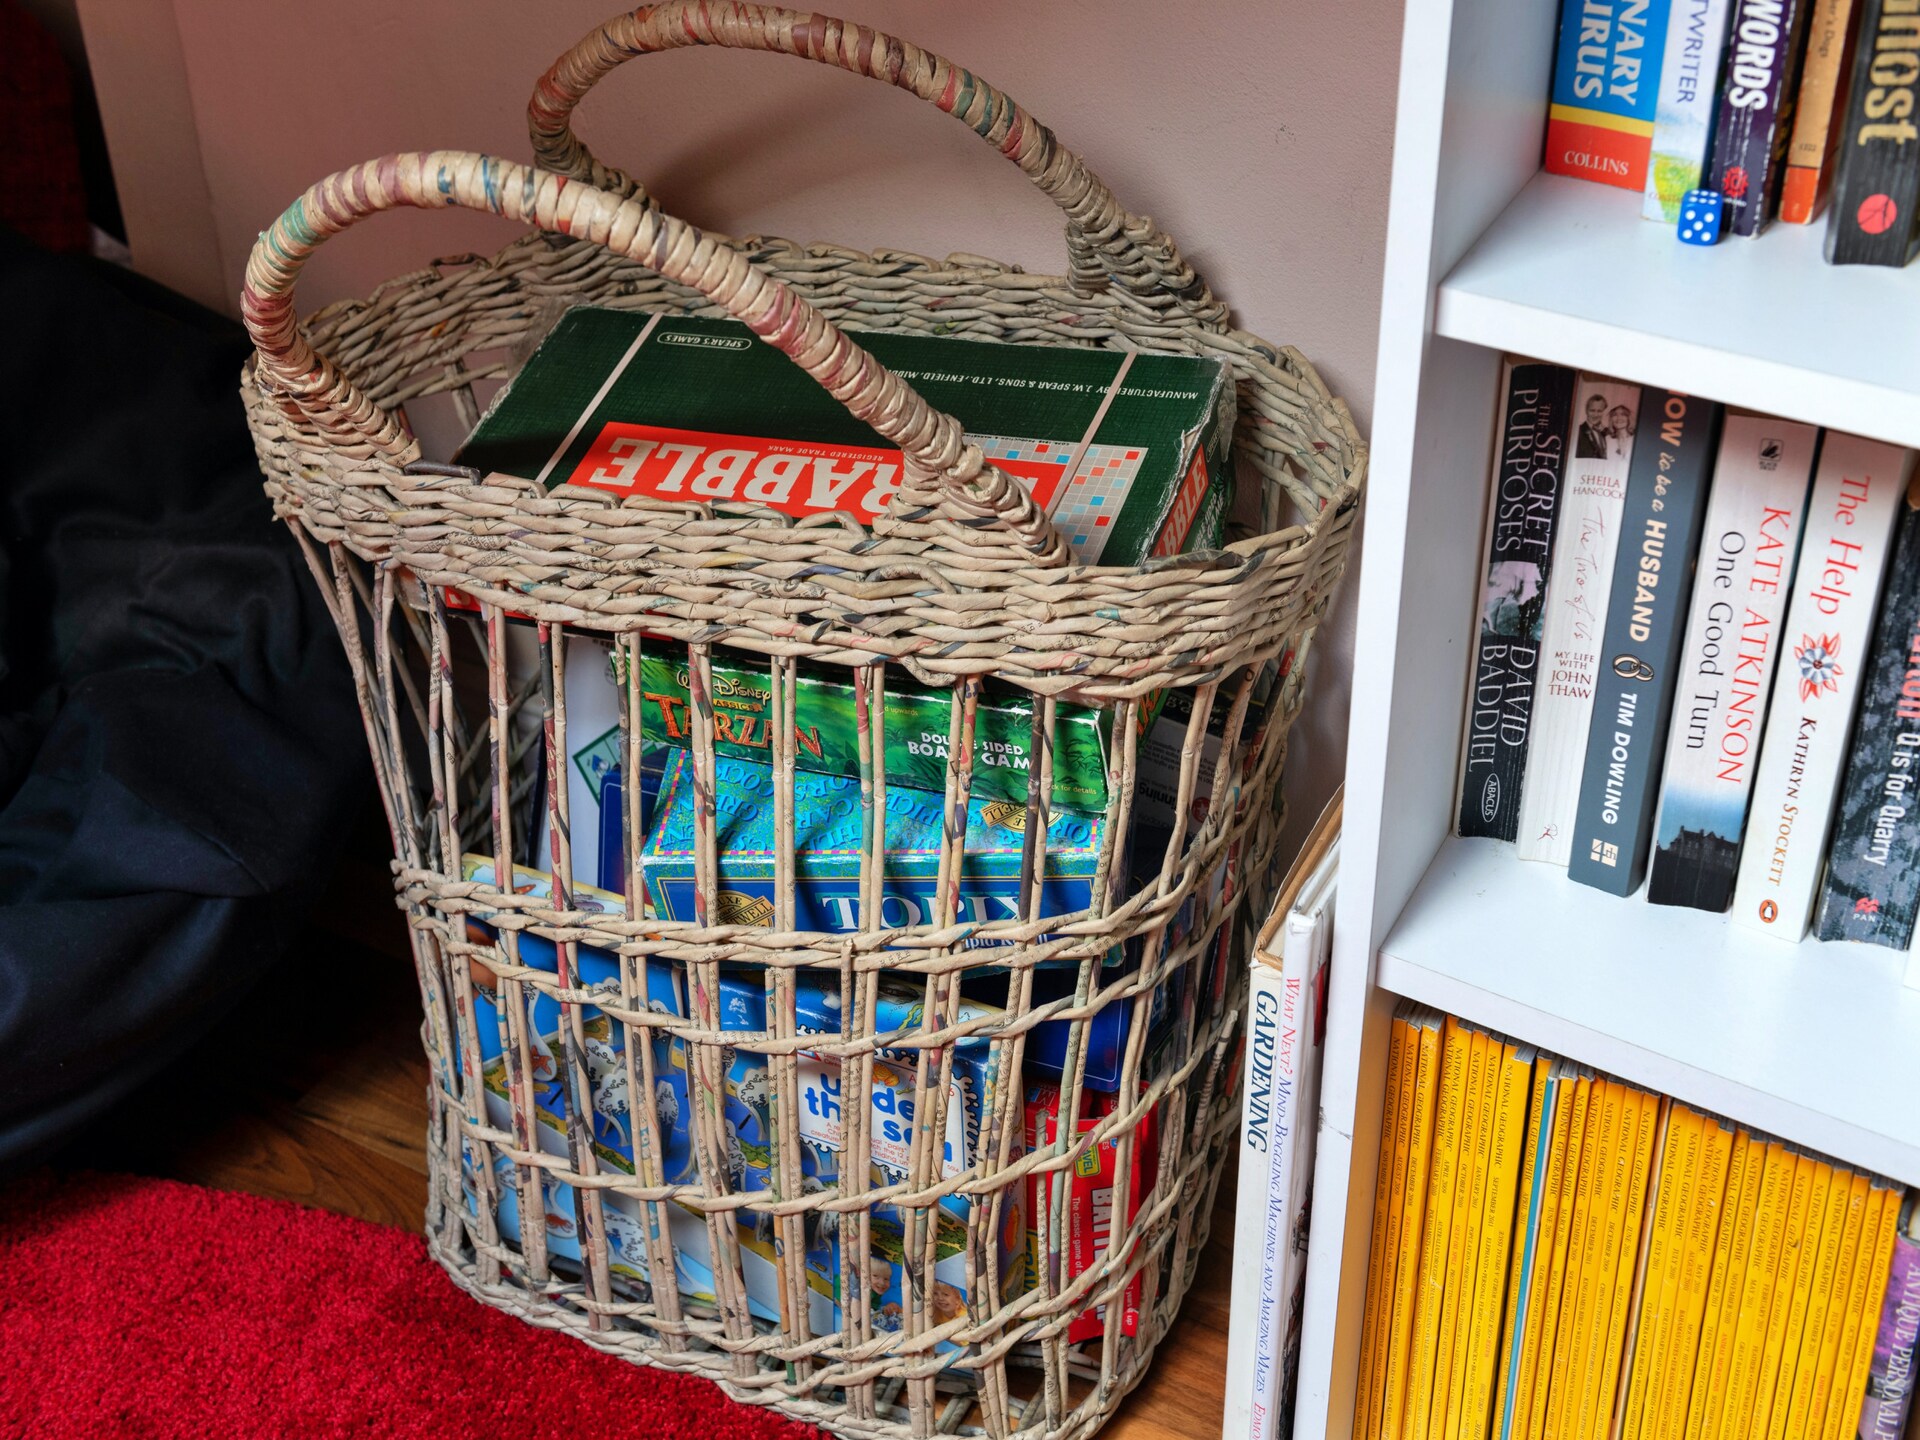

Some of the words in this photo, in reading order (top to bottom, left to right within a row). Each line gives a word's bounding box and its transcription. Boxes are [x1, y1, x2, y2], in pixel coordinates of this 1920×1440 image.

[1563, 149, 1630, 176] COLLINS
[665, 334, 701, 344] GAMES
[702, 337, 744, 348] SPEAR'S
[1028, 380, 1037, 388] &
[1096, 385, 1110, 394] BY
[1115, 386, 1199, 400] MANUFACTURE
[767, 445, 794, 453] MARK
[797, 447, 826, 456] TRADE
[829, 451, 884, 461] REGISTERED
[1495, 388, 1540, 552] PURPOSES
[588, 436, 904, 516] RABBLE
[1523, 432, 1562, 556] SECRET
[1572, 486, 1625, 500] HANCOCK
[1579, 474, 1621, 489] SHEILA
[1654, 473, 1673, 496] be
[1651, 498, 1665, 513] a
[1834, 475, 1871, 527] The
[1580, 506, 1605, 551] The
[1749, 505, 1792, 595] KATE
[1574, 553, 1599, 589] Two
[1629, 517, 1668, 643] HUSBAND
[1713, 531, 1746, 589] One
[1810, 536, 1864, 616] Help
[1554, 651, 1570, 660] MY
[1573, 651, 1595, 663] LIFE
[1698, 601, 1734, 677] Good
[1551, 669, 1593, 685] JOHN
[1558, 659, 1588, 670] WITH
[712, 698, 764, 713] ASSICS
[1468, 643, 1508, 773] BADDIEL
[1500, 645, 1537, 747] DAVID
[1548, 684, 1593, 700] THAW
[1617, 691, 1638, 728] TIM
[1716, 606, 1771, 785] ATKINSON
[920, 731, 978, 751] DOUE
[982, 740, 1024, 756] SIDED
[1686, 689, 1719, 750] Turn
[981, 752, 1031, 771] GAM
[1602, 733, 1632, 825] DOWLING
[1786, 716, 1818, 799] KATHRYN
[1891, 751, 1920, 769] is
[1061, 783, 1073, 792] for
[1073, 785, 1097, 795] details
[1137, 780, 1177, 811] inning
[1484, 780, 1498, 817] ABACUS
[1884, 771, 1914, 800] for
[1767, 803, 1799, 887] STOCKETT
[1863, 804, 1907, 867] Quarry
[817, 893, 1020, 931] TOIX
[1852, 913, 1877, 923] PAN
[1283, 977, 1301, 1023] WHAT
[1246, 990, 1279, 1154] GARDENING
[1279, 1024, 1297, 1076] NEXT?
[1391, 1037, 1400, 1084] NATIONAL
[1404, 1043, 1414, 1089] NATIONAL
[1444, 1036, 1455, 1082] NATIONAL
[1452, 1048, 1462, 1093] NATIONAL
[1470, 1051, 1480, 1097] NATIONAL
[819, 1072, 915, 1122] ude
[1485, 1055, 1496, 1100] NATIONAL
[804, 1086, 842, 1123] th
[1384, 1086, 1396, 1142] GEOGRAPHIC
[1398, 1091, 1410, 1147] GEOGRAPHIC
[1412, 1091, 1425, 1148] GEOGRAPHIC
[1438, 1084, 1449, 1141] GEOGRAPHIC
[1447, 1094, 1457, 1152] GEOGRAPHIC
[1463, 1099, 1475, 1156] GEOGRAPHIC
[1532, 1080, 1544, 1127] NATIONAL
[1558, 1092, 1572, 1141] NATIONAL
[1571, 1094, 1584, 1142] NATIONAL
[1586, 1094, 1599, 1142] NATIONAL
[1602, 1102, 1614, 1144] NATIONAL
[1477, 1102, 1490, 1159] GEOGRAPHIC
[1495, 1111, 1508, 1167] GEOGRAPHIC
[1619, 1107, 1632, 1155] NATIONAL
[1637, 1111, 1650, 1158] NATIONAL
[1667, 1124, 1680, 1173] NATIONAL
[1525, 1127, 1538, 1184] GEOGRAPHIC
[1550, 1141, 1565, 1196] GEOGRAPHIC
[1563, 1144, 1576, 1200] GEOGRAPHIC
[1579, 1143, 1591, 1200] GEOGRAPHIC
[1594, 1144, 1607, 1200] GEOGRAPHIC
[1684, 1132, 1698, 1181] NATIONAL
[1701, 1135, 1715, 1184] NATIONAL
[1710, 1149, 1724, 1199] NATIONAL
[1730, 1146, 1744, 1195] NATIONAL
[1072, 1196, 1081, 1211] The
[1611, 1157, 1625, 1214] GEOGRAPHIC
[1628, 1160, 1644, 1218] GEOGRAPHIC
[1658, 1174, 1672, 1232] GEOGRAPHIC
[1745, 1156, 1759, 1206] NATIONAL
[1764, 1163, 1778, 1212] NATIONAL
[1776, 1169, 1790, 1218] NATIONAL
[1072, 1212, 1081, 1239] classic
[1263, 1194, 1283, 1262] MACHINES
[1675, 1183, 1689, 1240] GEOGRAPHIC
[1692, 1185, 1707, 1242] GEOGRAPHIC
[1700, 1200, 1714, 1256] GEOGRAPHIC
[1721, 1196, 1735, 1254] GEOGRAPHIC
[1809, 1184, 1824, 1233] NATIONAL
[1830, 1189, 1845, 1238] NATIONAL
[1072, 1239, 1082, 1261] game
[1734, 1207, 1750, 1264] GEOGRAPHIC
[1753, 1213, 1770, 1271] GEOGRAPHIC
[1767, 1219, 1782, 1276] GEOGRAPHIC
[1864, 1209, 1879, 1258] NATIONAL
[1880, 1208, 1895, 1259] NATIONAL
[1799, 1234, 1815, 1292] GEOGRAPHIC
[1819, 1239, 1835, 1297] GEOGRAPHIC
[1853, 1259, 1868, 1317] GEOGRAPHIC
[1869, 1260, 1885, 1318] GEOGRAPHIC
[1894, 1262, 1920, 1343] ANTIQUE
[1126, 1315, 1134, 1326] up
[1258, 1292, 1275, 1351] AMAZING
[1255, 1352, 1271, 1394] MAZES
[1876, 1343, 1914, 1427] PERSONAL
